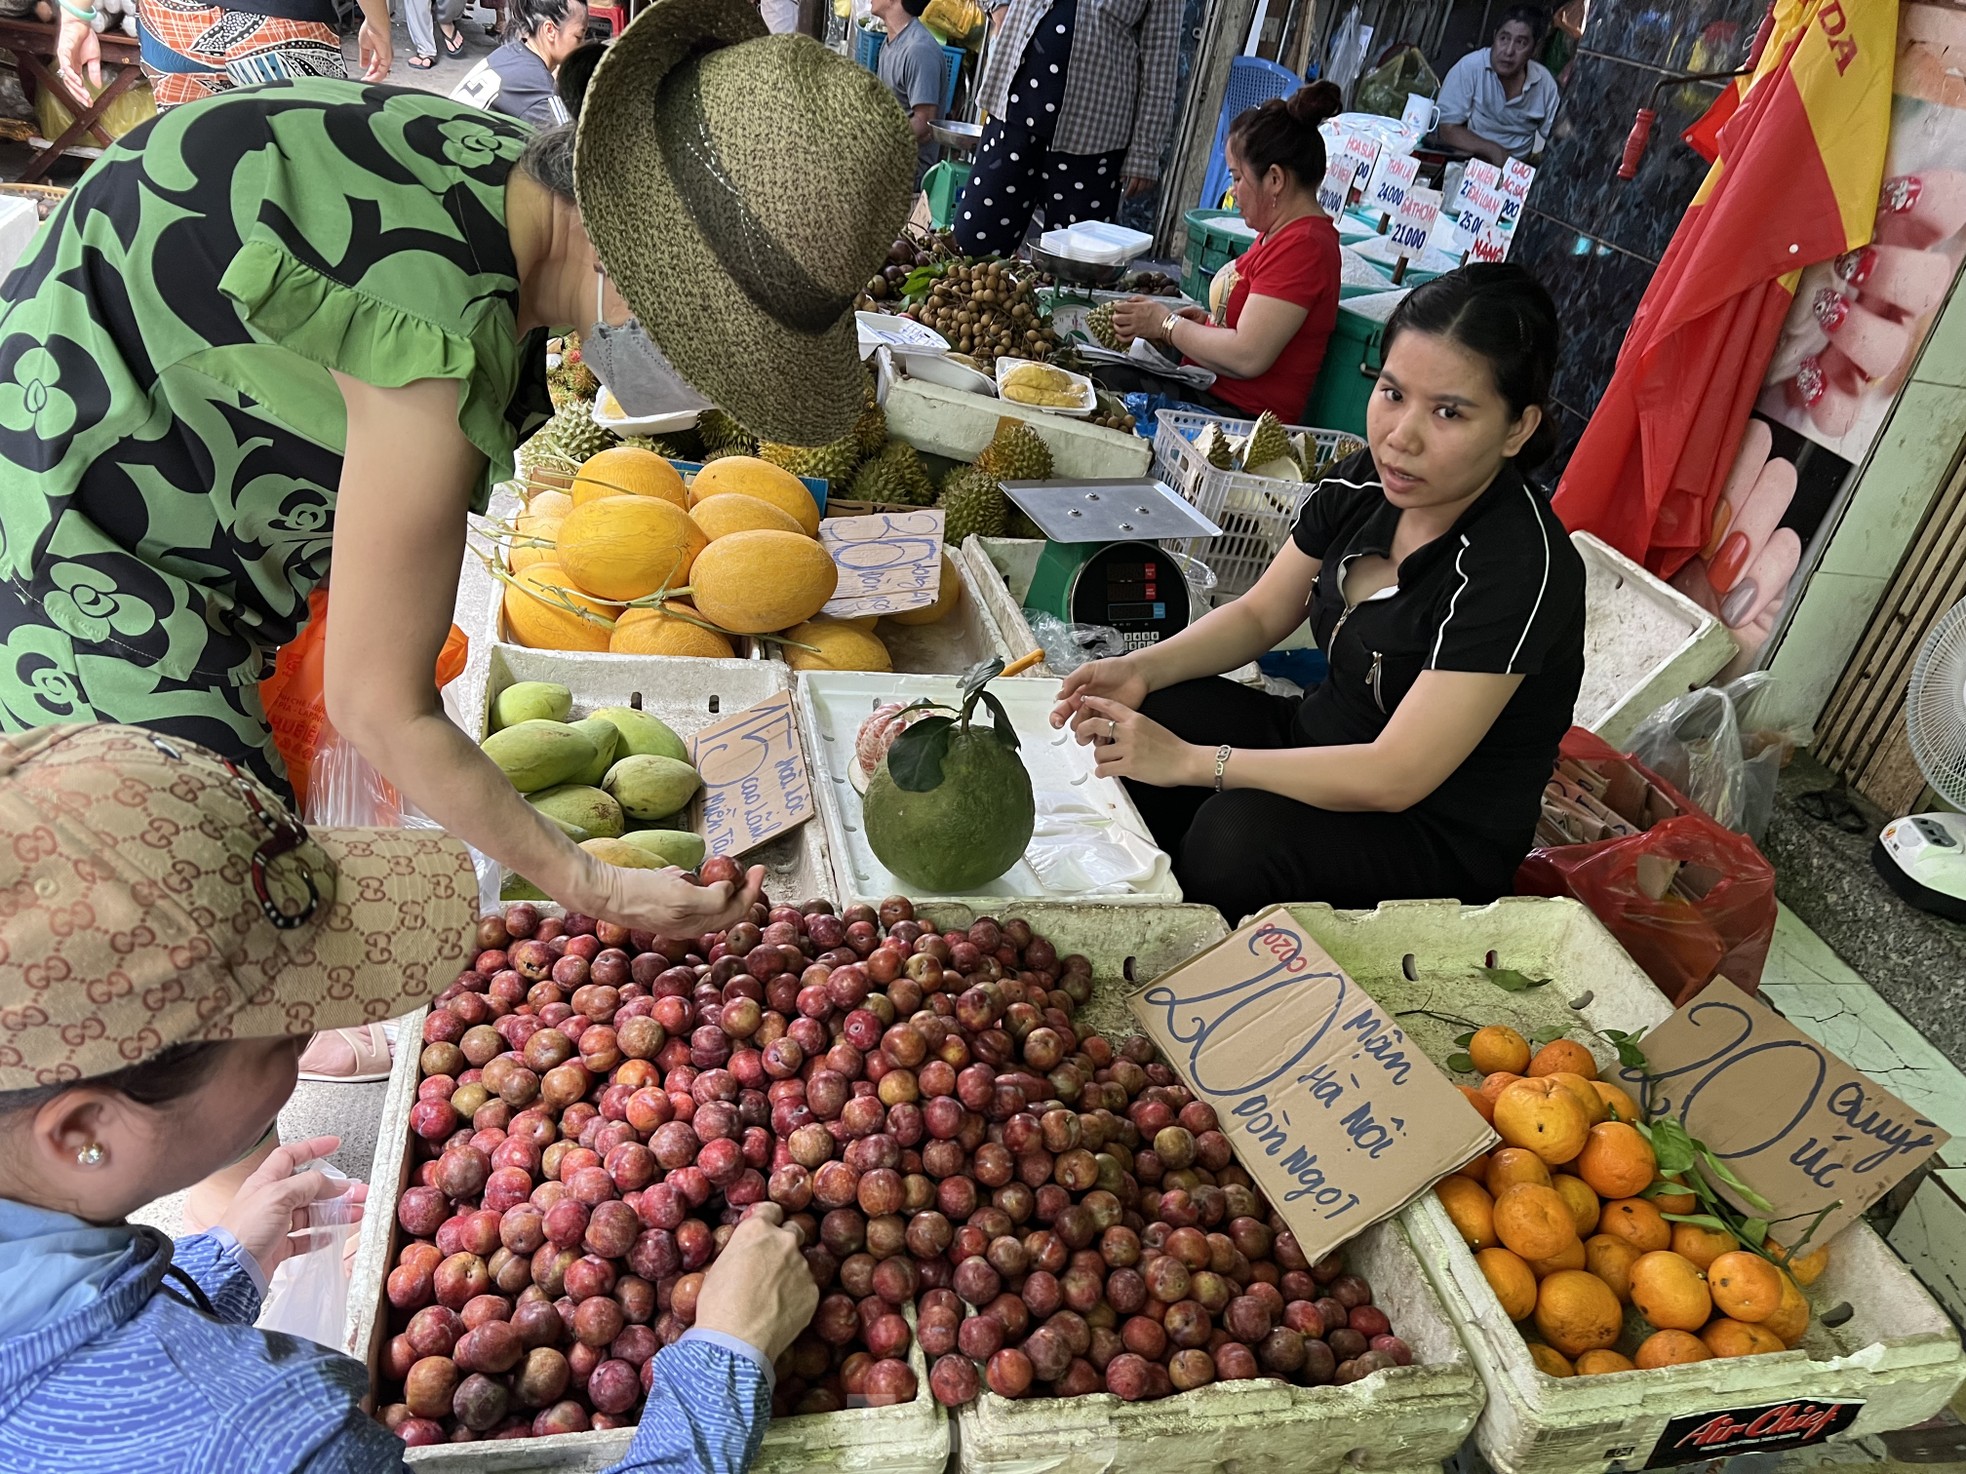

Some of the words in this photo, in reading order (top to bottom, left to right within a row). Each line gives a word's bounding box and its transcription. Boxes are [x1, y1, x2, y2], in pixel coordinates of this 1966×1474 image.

[694, 703, 792, 788] 15
[1144, 927, 1346, 1096] 20
[1297, 1064, 1360, 1109] Hà
[1619, 1002, 1826, 1159] 20
[1673, 1413, 1748, 1449] Air
[1743, 1403, 1843, 1440] Chief
